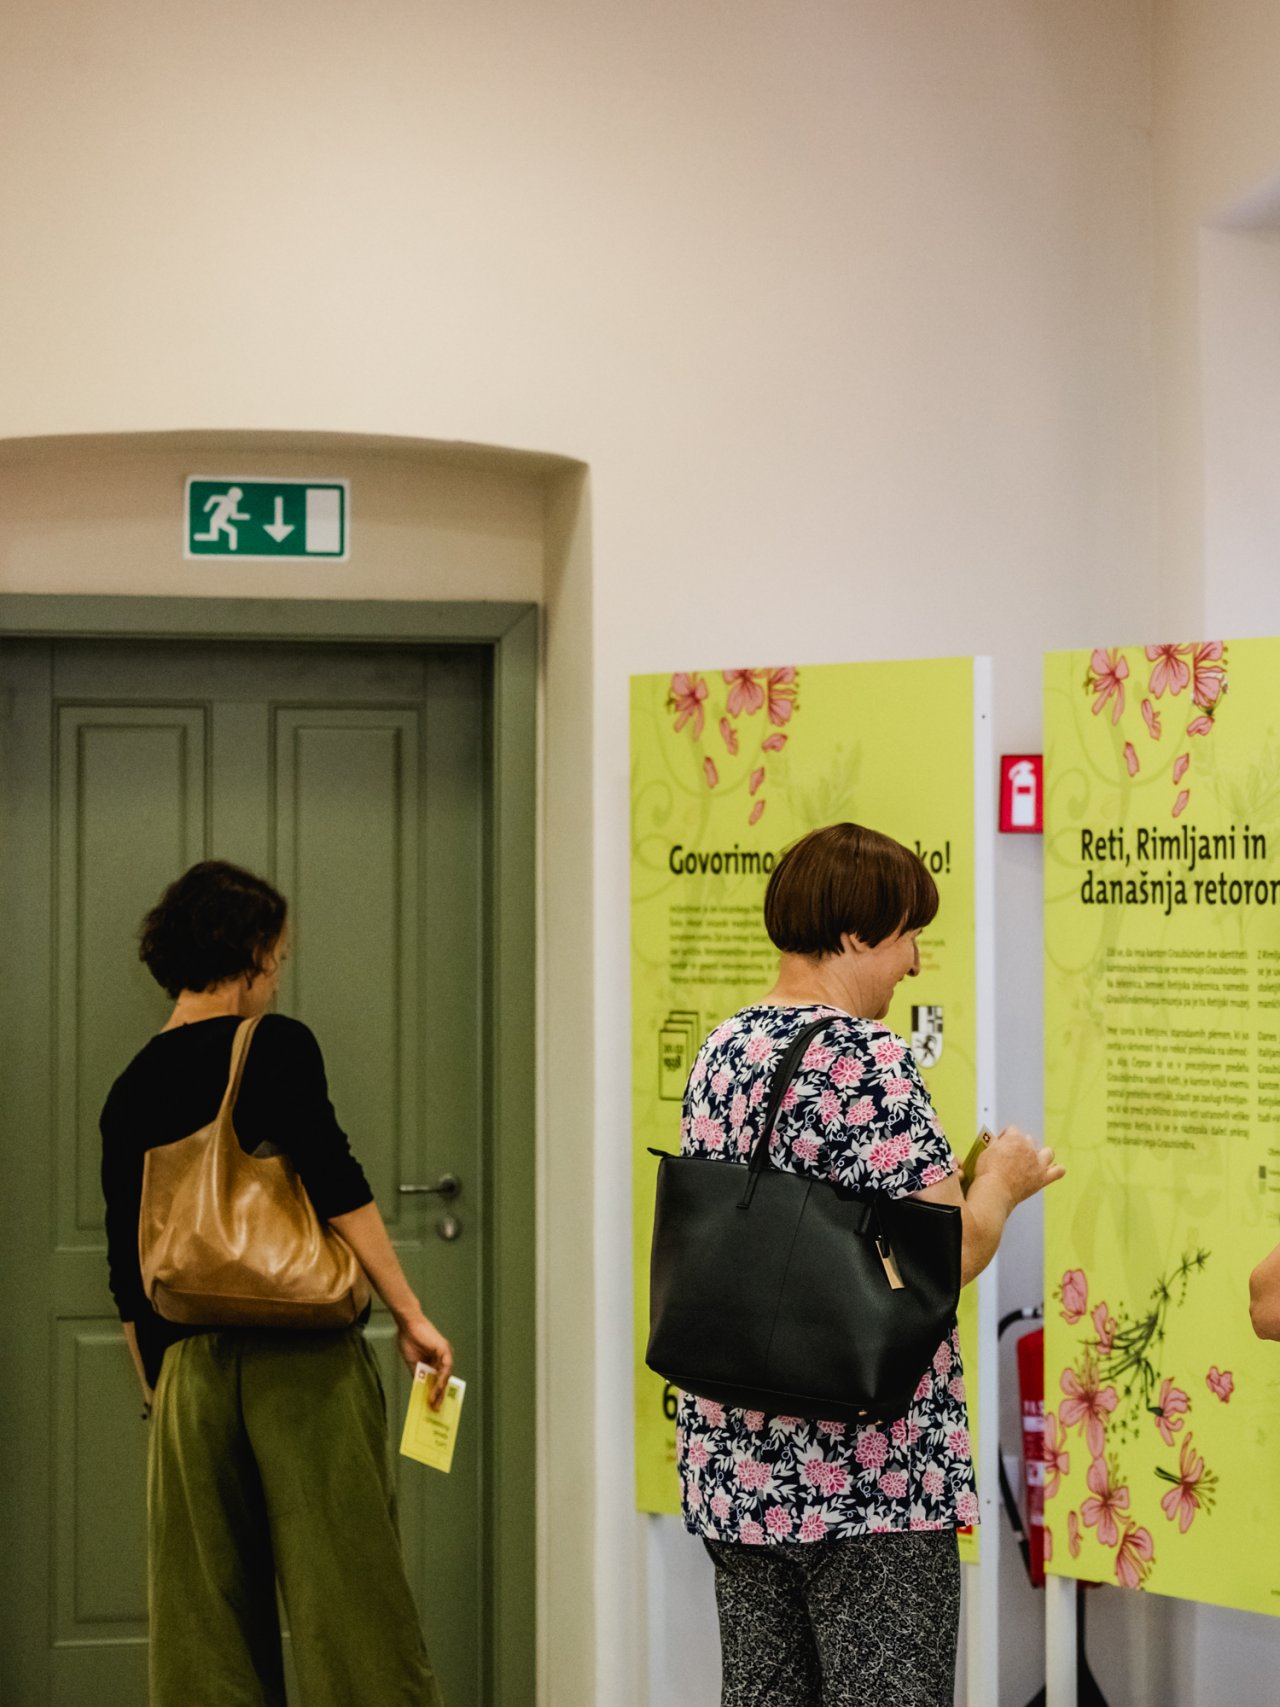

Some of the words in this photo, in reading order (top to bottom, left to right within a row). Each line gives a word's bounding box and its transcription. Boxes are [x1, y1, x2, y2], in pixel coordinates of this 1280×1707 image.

[669, 843, 775, 875] Govorimo
[1081, 827, 1130, 867] Reti,
[1137, 825, 1235, 872] Rimljani
[1243, 825, 1267, 860] in
[1081, 870, 1188, 916] današnja
[663, 1384, 678, 1420] 6
